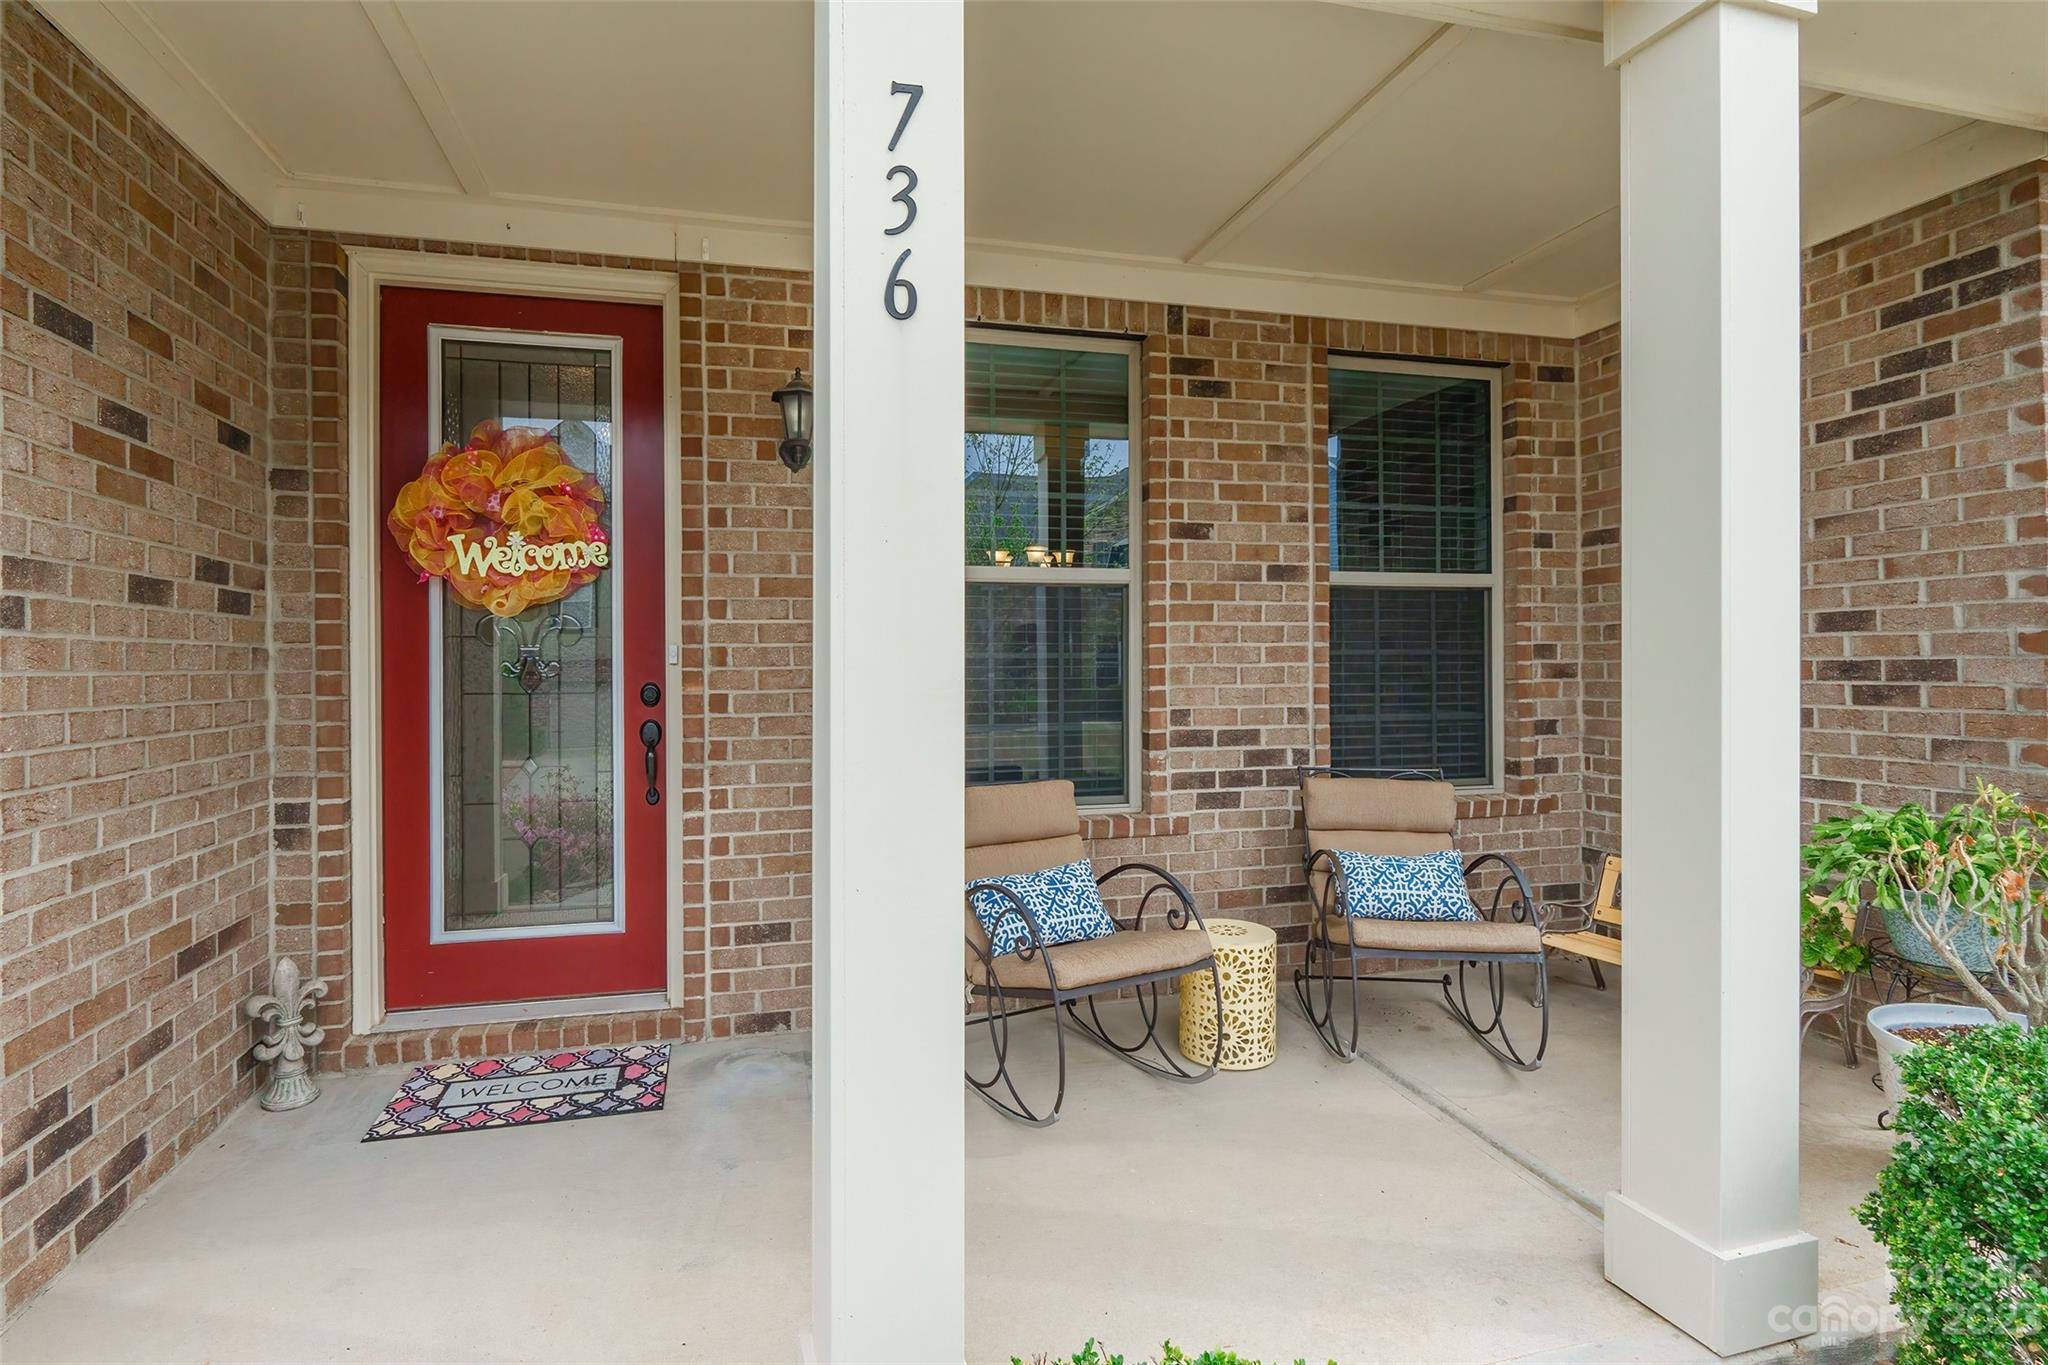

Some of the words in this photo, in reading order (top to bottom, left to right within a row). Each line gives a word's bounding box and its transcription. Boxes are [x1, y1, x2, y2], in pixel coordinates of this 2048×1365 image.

[884, 80, 924, 320] 736
[447, 531, 609, 577] Welcome
[460, 1072, 608, 1099] WELCOME
